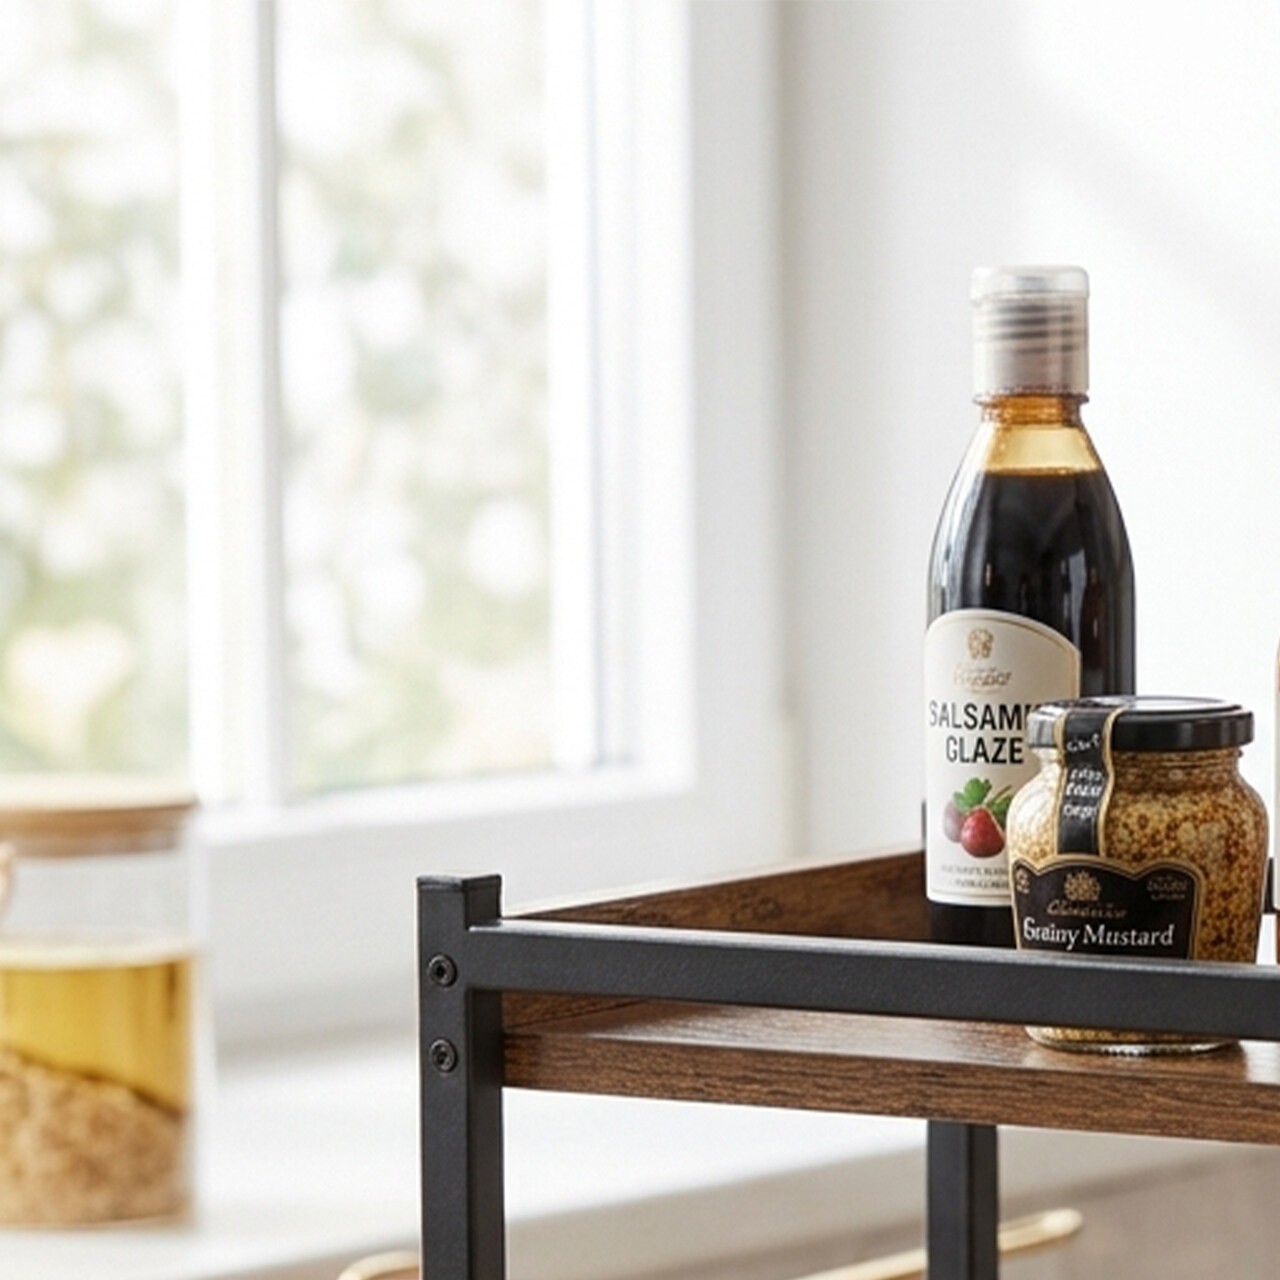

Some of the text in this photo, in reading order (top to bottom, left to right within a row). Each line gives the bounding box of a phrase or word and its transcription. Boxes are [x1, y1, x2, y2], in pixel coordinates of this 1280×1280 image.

[946, 735, 1024, 764] GLAZE
[1023, 916, 1175, 950] Grainy Mustard
